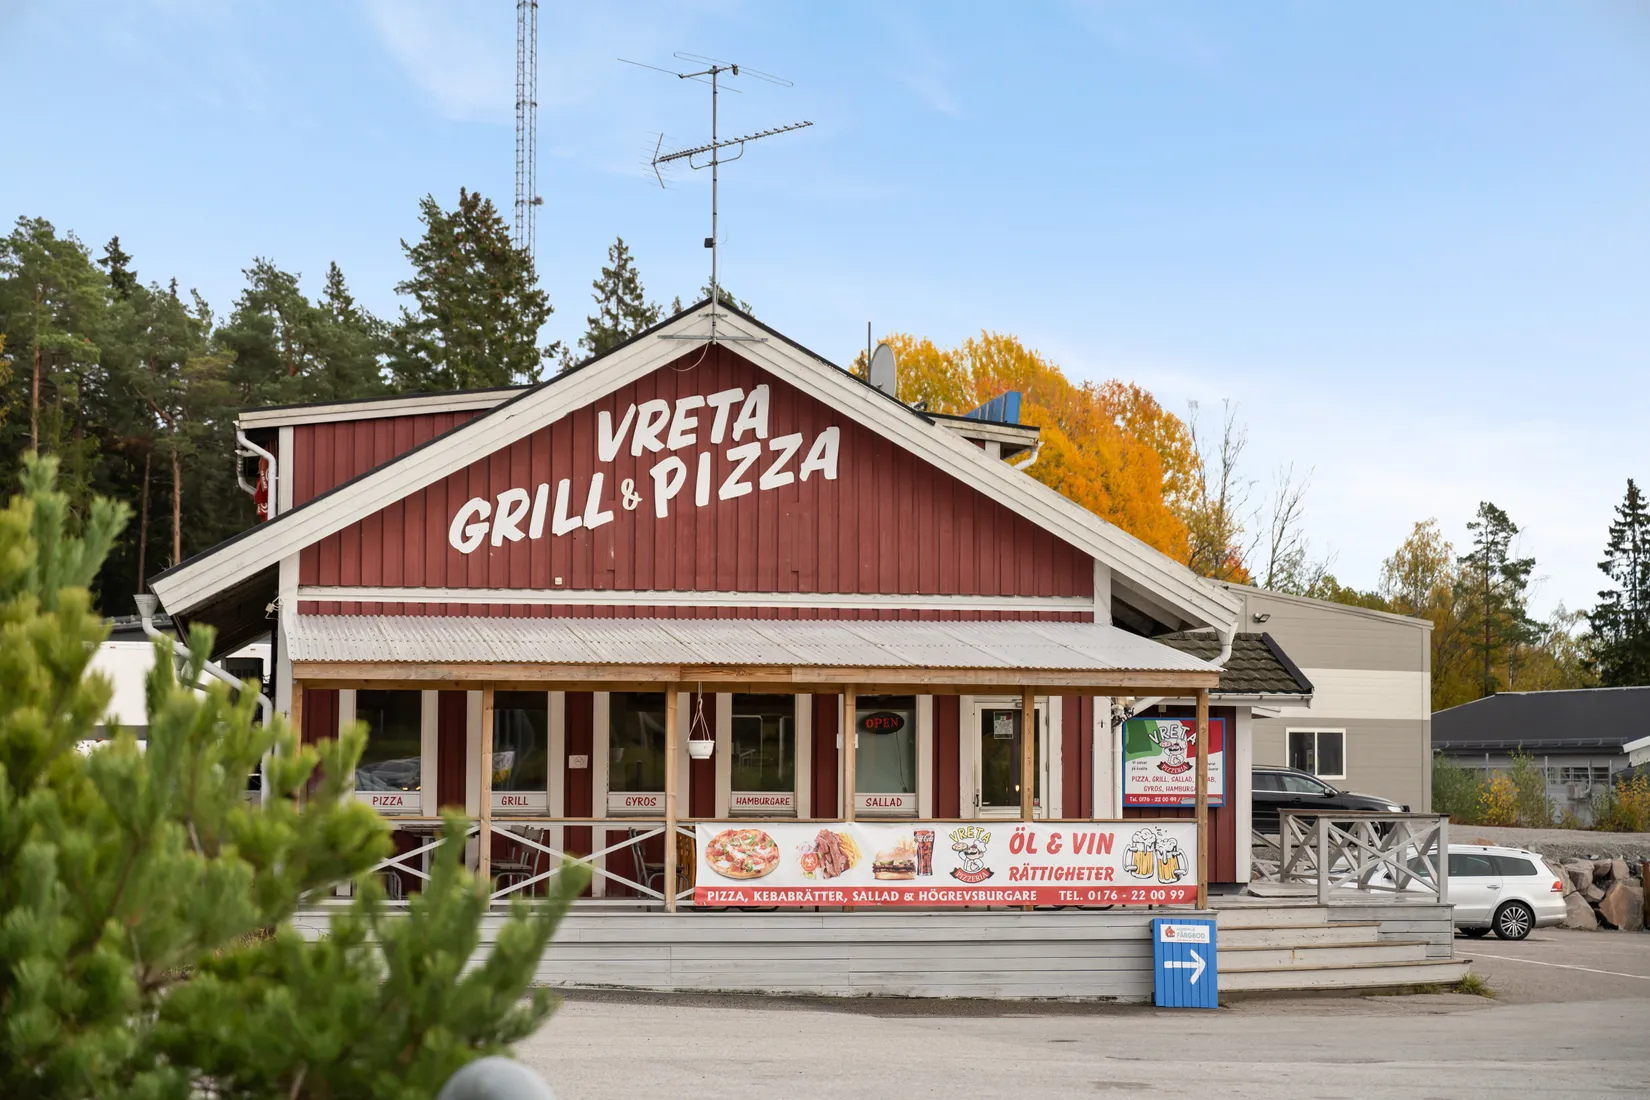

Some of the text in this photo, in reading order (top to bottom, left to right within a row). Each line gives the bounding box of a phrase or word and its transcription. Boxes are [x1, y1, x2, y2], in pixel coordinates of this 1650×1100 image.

[598, 384, 770, 462] VRETA
[448, 426, 840, 554] GRILL & PIZZA
[865, 717, 899, 729] OPEN
[1149, 724, 1197, 745] VRETA
[1161, 764, 1188, 774] PIZZERIA
[1131, 775, 1194, 783] PIZZA, GRILL, SALLAD,
[372, 795, 403, 806] PIZZA
[501, 795, 529, 806] GRILL
[625, 796, 657, 807] GYROS
[736, 796, 791, 806] HAMBURGARE
[865, 797, 903, 807] SALLAD
[949, 825, 992, 844] VRETA
[1009, 826, 1115, 854] ÖL & VIN
[955, 871, 989, 882] PIZZERIA
[1008, 862, 1114, 882] RÄTTIGHETER
[707, 887, 1037, 903] PIZZA, KEBABRÄTTER, SALLAD & HÖGREVSBURGARE
[1059, 890, 1083, 901] TEL.
[1087, 890, 1118, 901] 0176
[1131, 890, 1146, 901] 22
[1150, 890, 1166, 901] 00
[1170, 890, 1185, 901] 99
